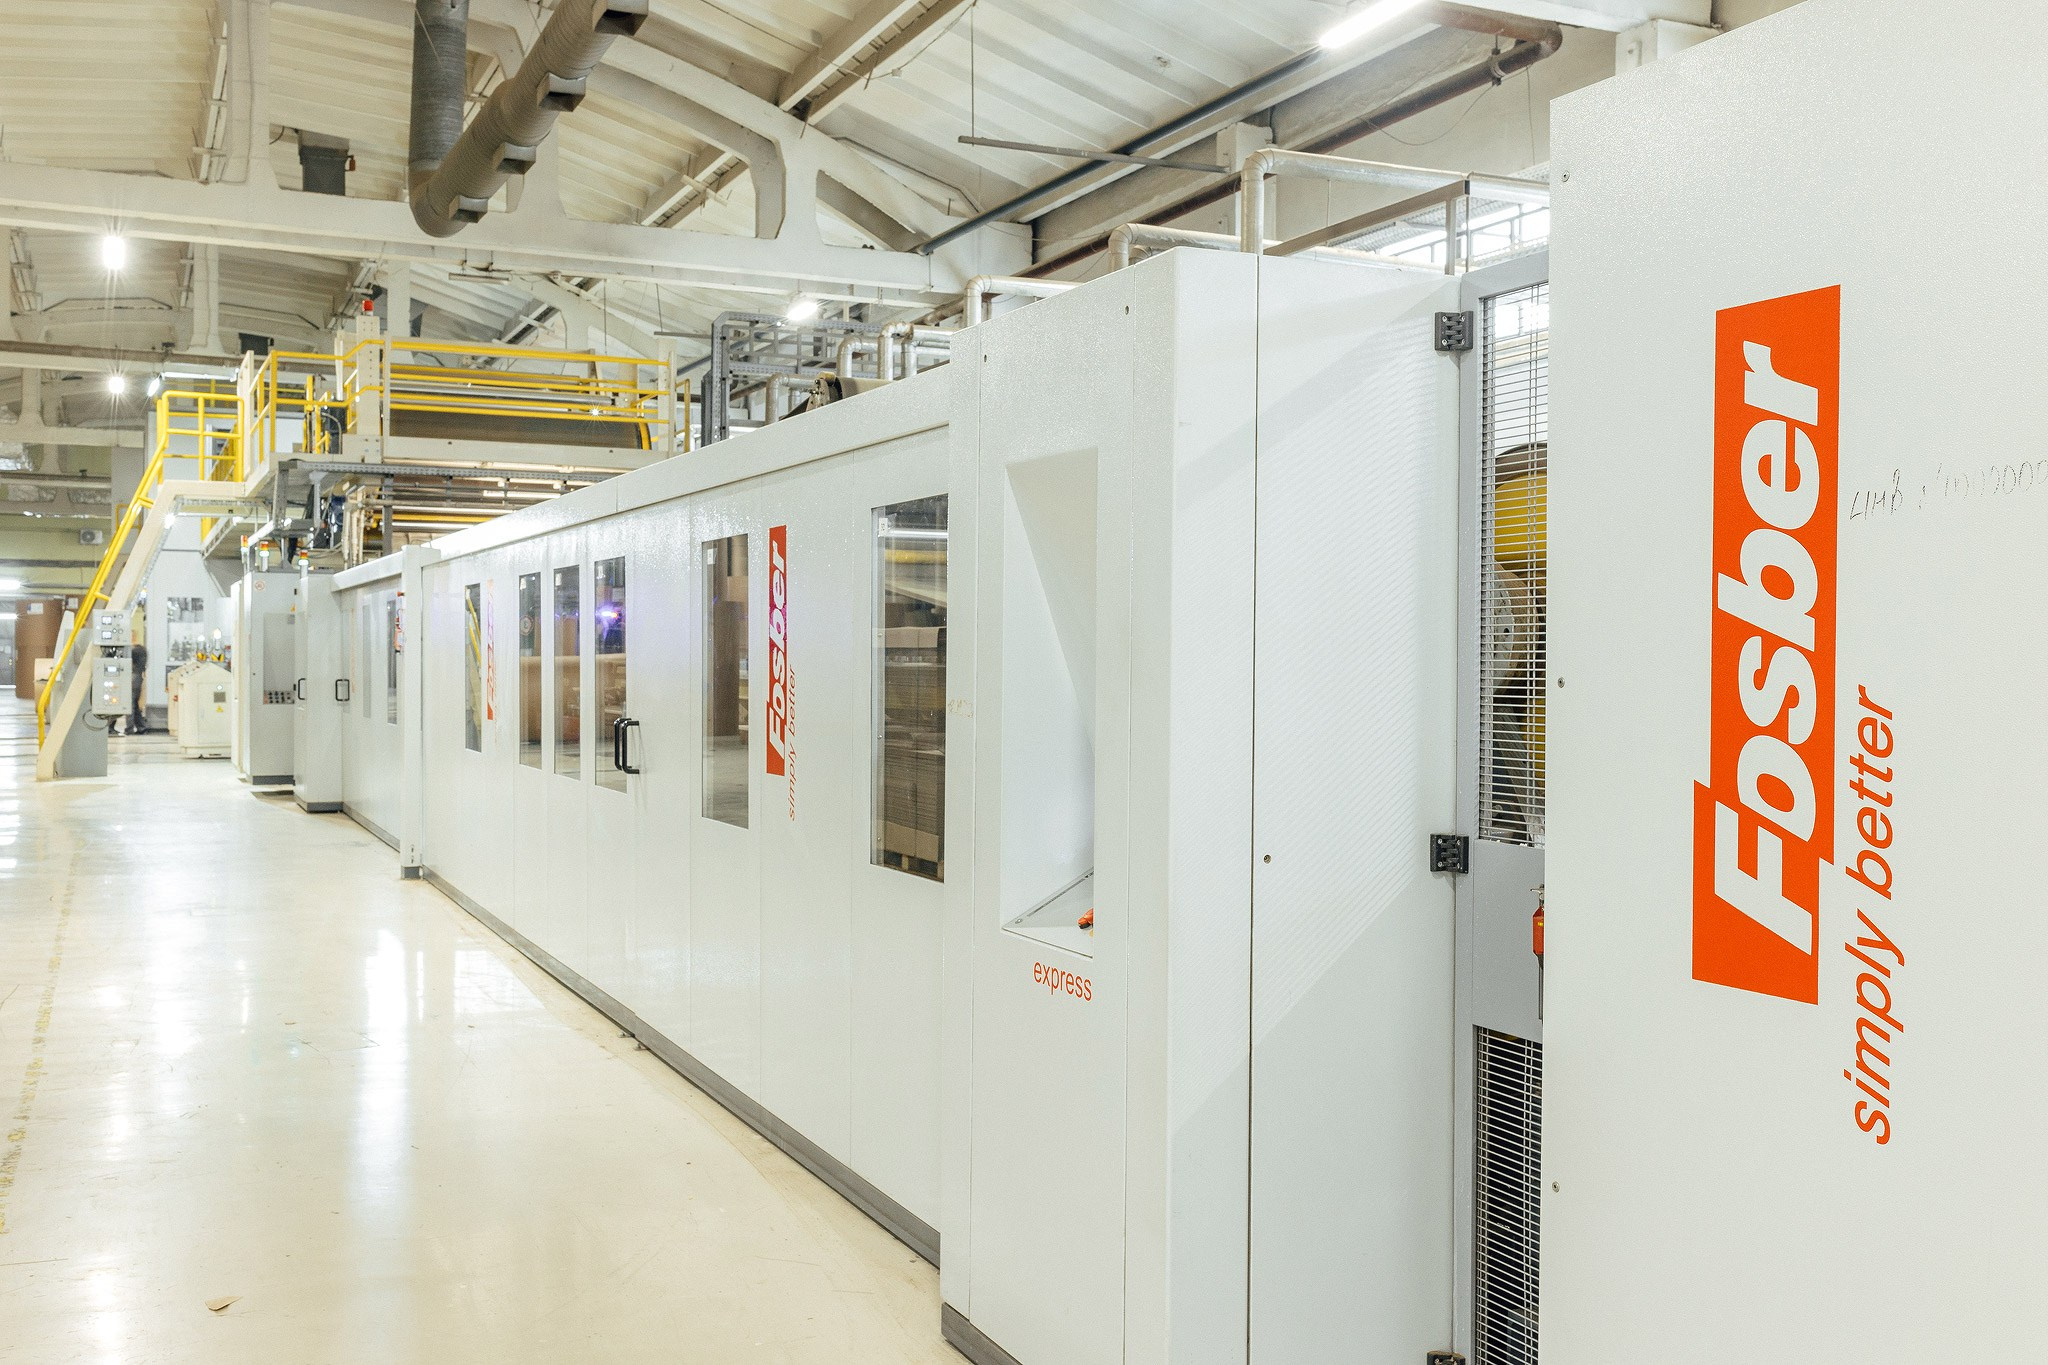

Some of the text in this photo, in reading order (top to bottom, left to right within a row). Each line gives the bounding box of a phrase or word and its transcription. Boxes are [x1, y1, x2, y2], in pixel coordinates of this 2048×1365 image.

[769, 541, 787, 760] Fosber
[788, 664, 797, 822] simply better
[1713, 340, 1821, 956] Fosber
[1033, 961, 1092, 1001] express
[1843, 684, 1905, 1146] simply better
